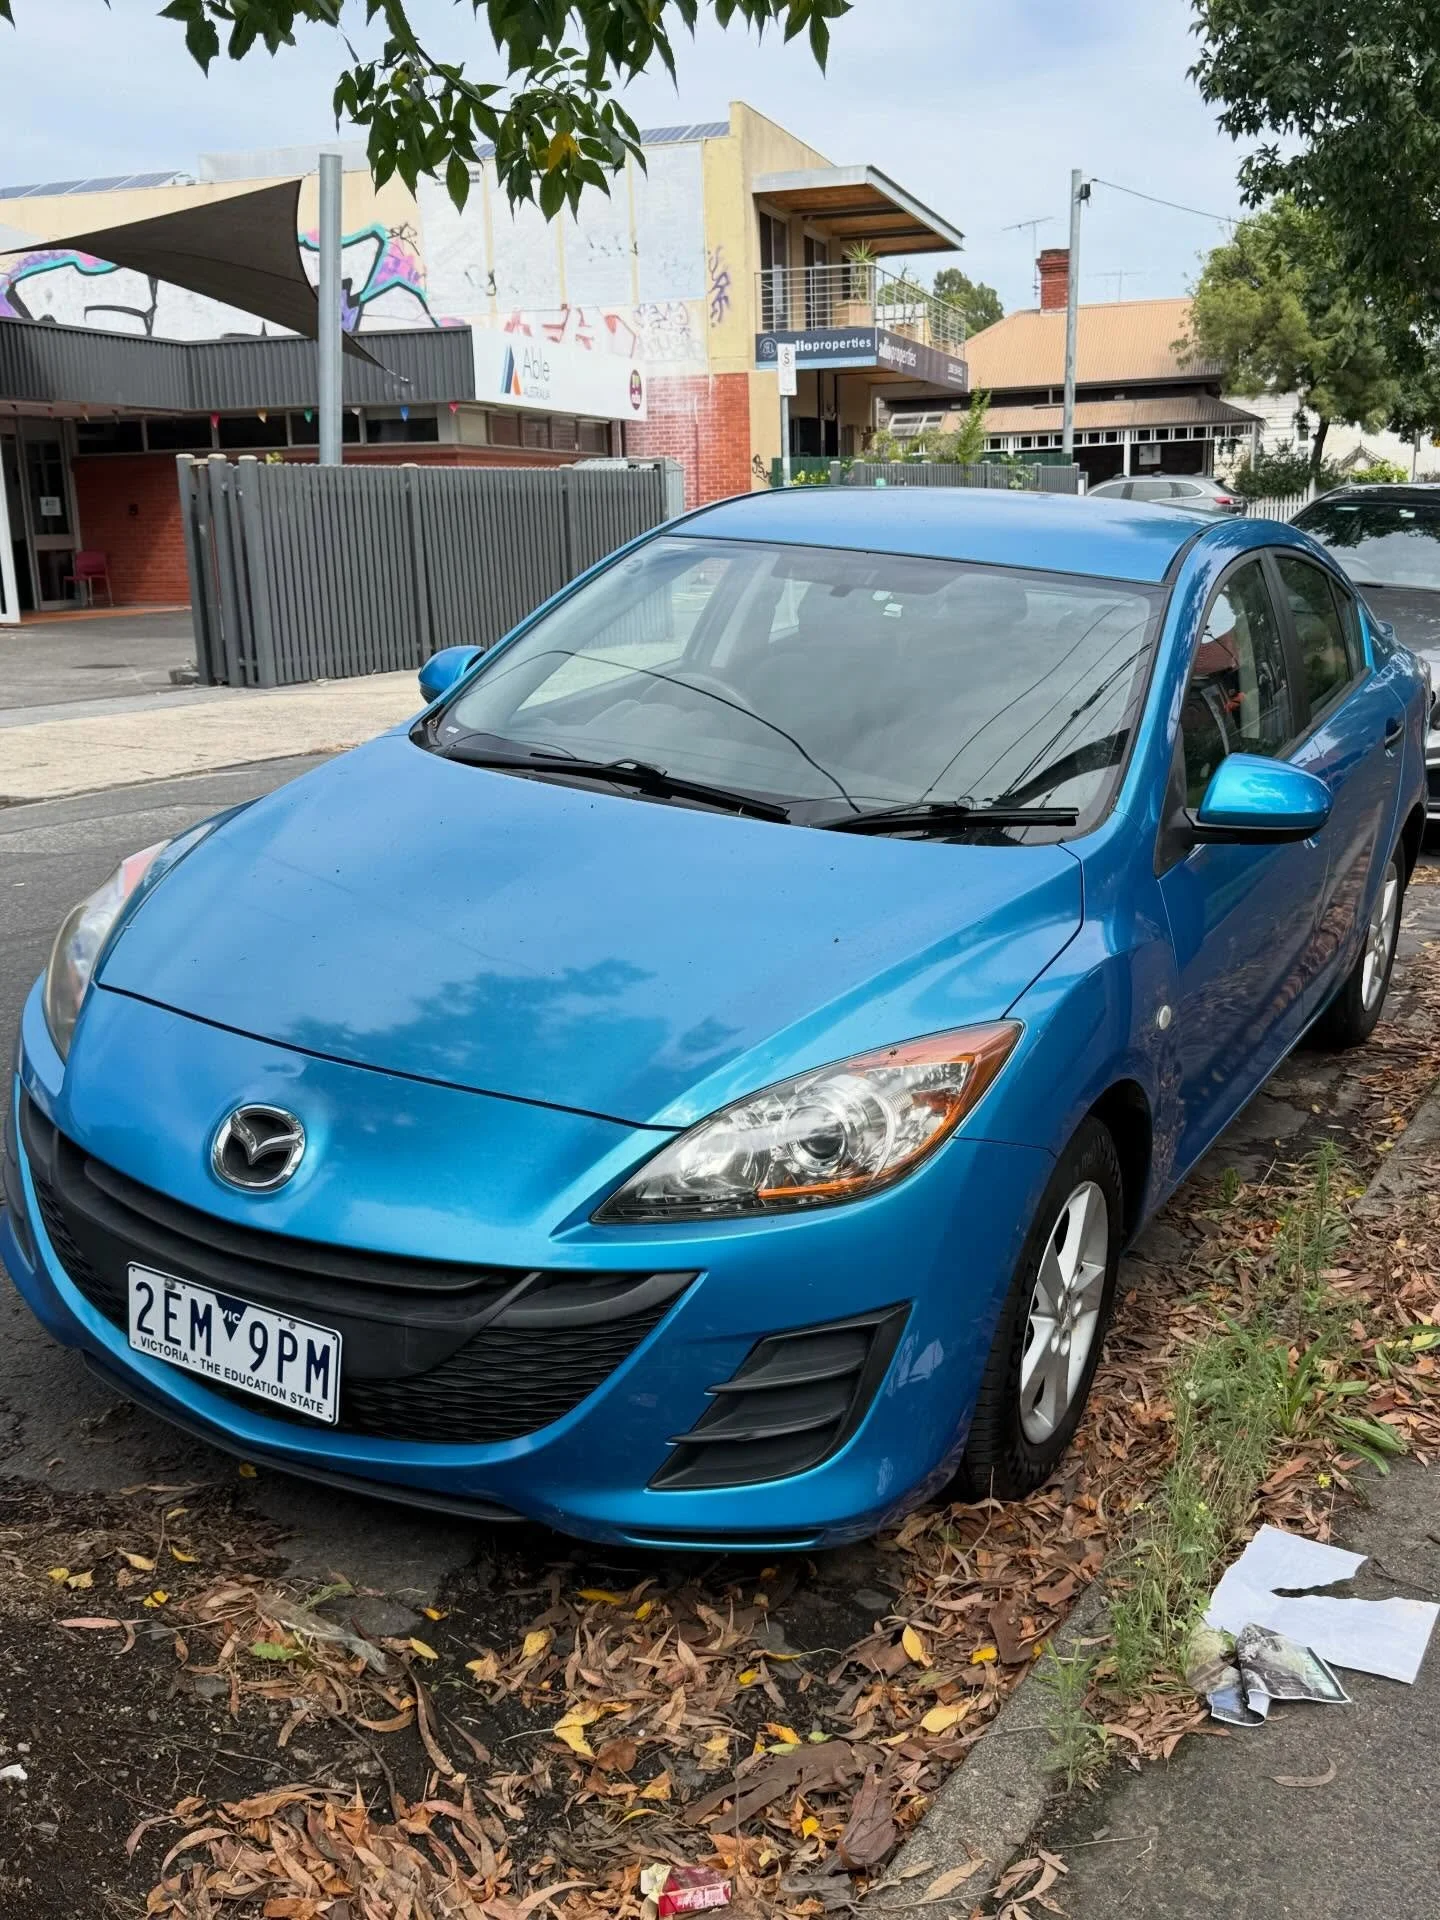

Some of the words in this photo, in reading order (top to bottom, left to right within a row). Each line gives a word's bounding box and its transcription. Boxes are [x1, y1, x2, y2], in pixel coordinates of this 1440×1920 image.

[522, 346, 551, 382] Able
[135, 1281, 213, 1357] 2EM
[249, 1320, 331, 1400] 9PM
[222, 1309, 241, 1325] VIC
[140, 1335, 189, 1364] VICTORIA
[200, 1358, 221, 1376] THE
[224, 1367, 287, 1400] EDUCATION
[290, 1392, 324, 1414] STATE
